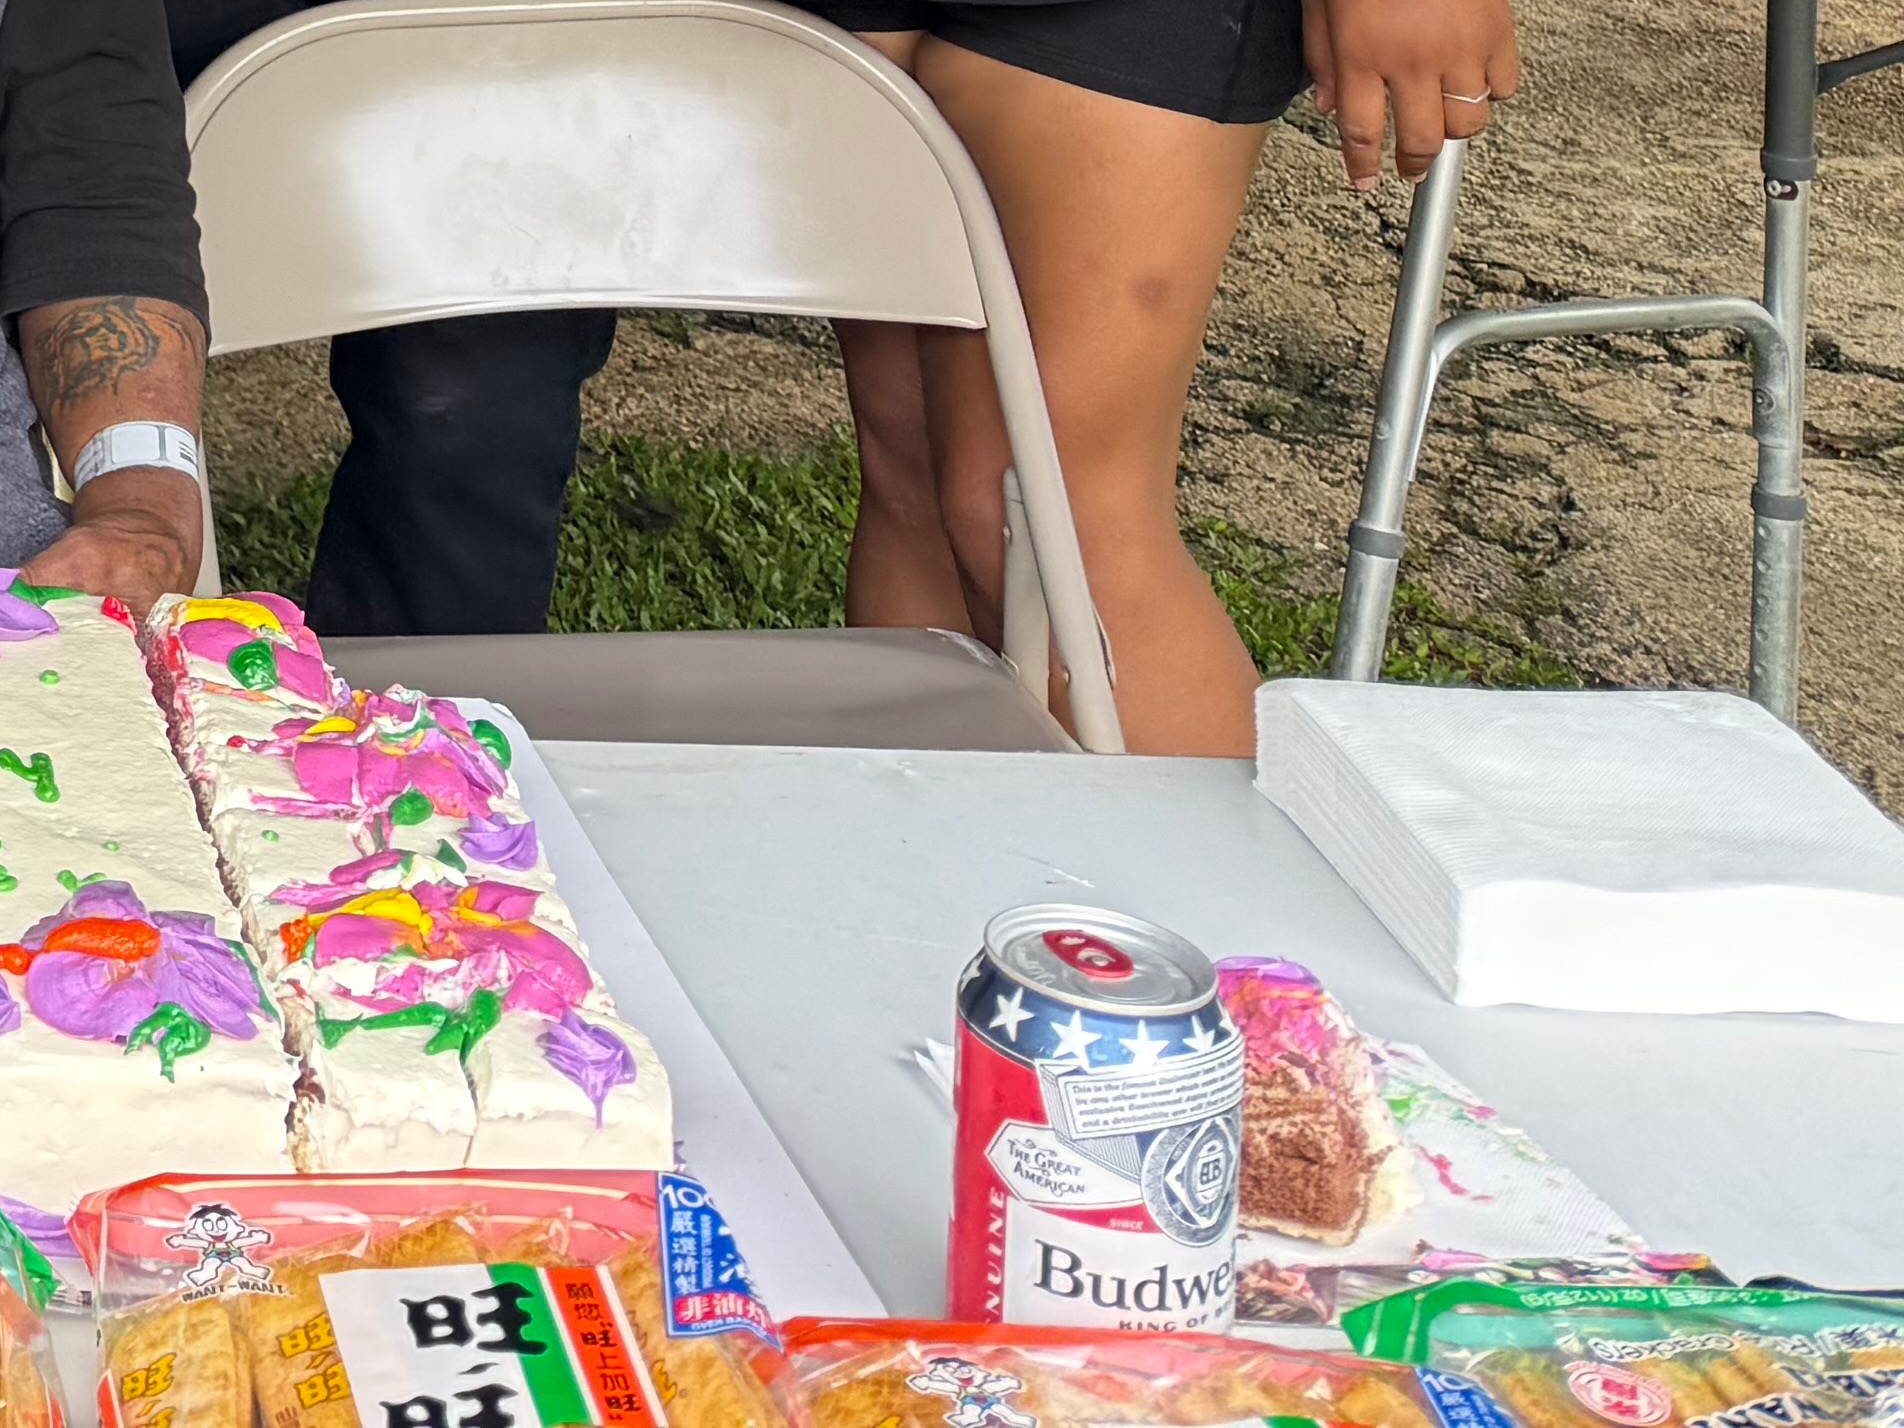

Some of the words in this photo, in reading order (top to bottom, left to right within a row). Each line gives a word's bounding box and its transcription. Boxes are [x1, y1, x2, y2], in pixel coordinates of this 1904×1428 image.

[1012, 1161, 1087, 1195] AMERICAN
[1034, 1150, 1082, 1178] GREAT
[986, 1186, 1005, 1324] NUINE
[1033, 1238, 1236, 1314] Budwe
